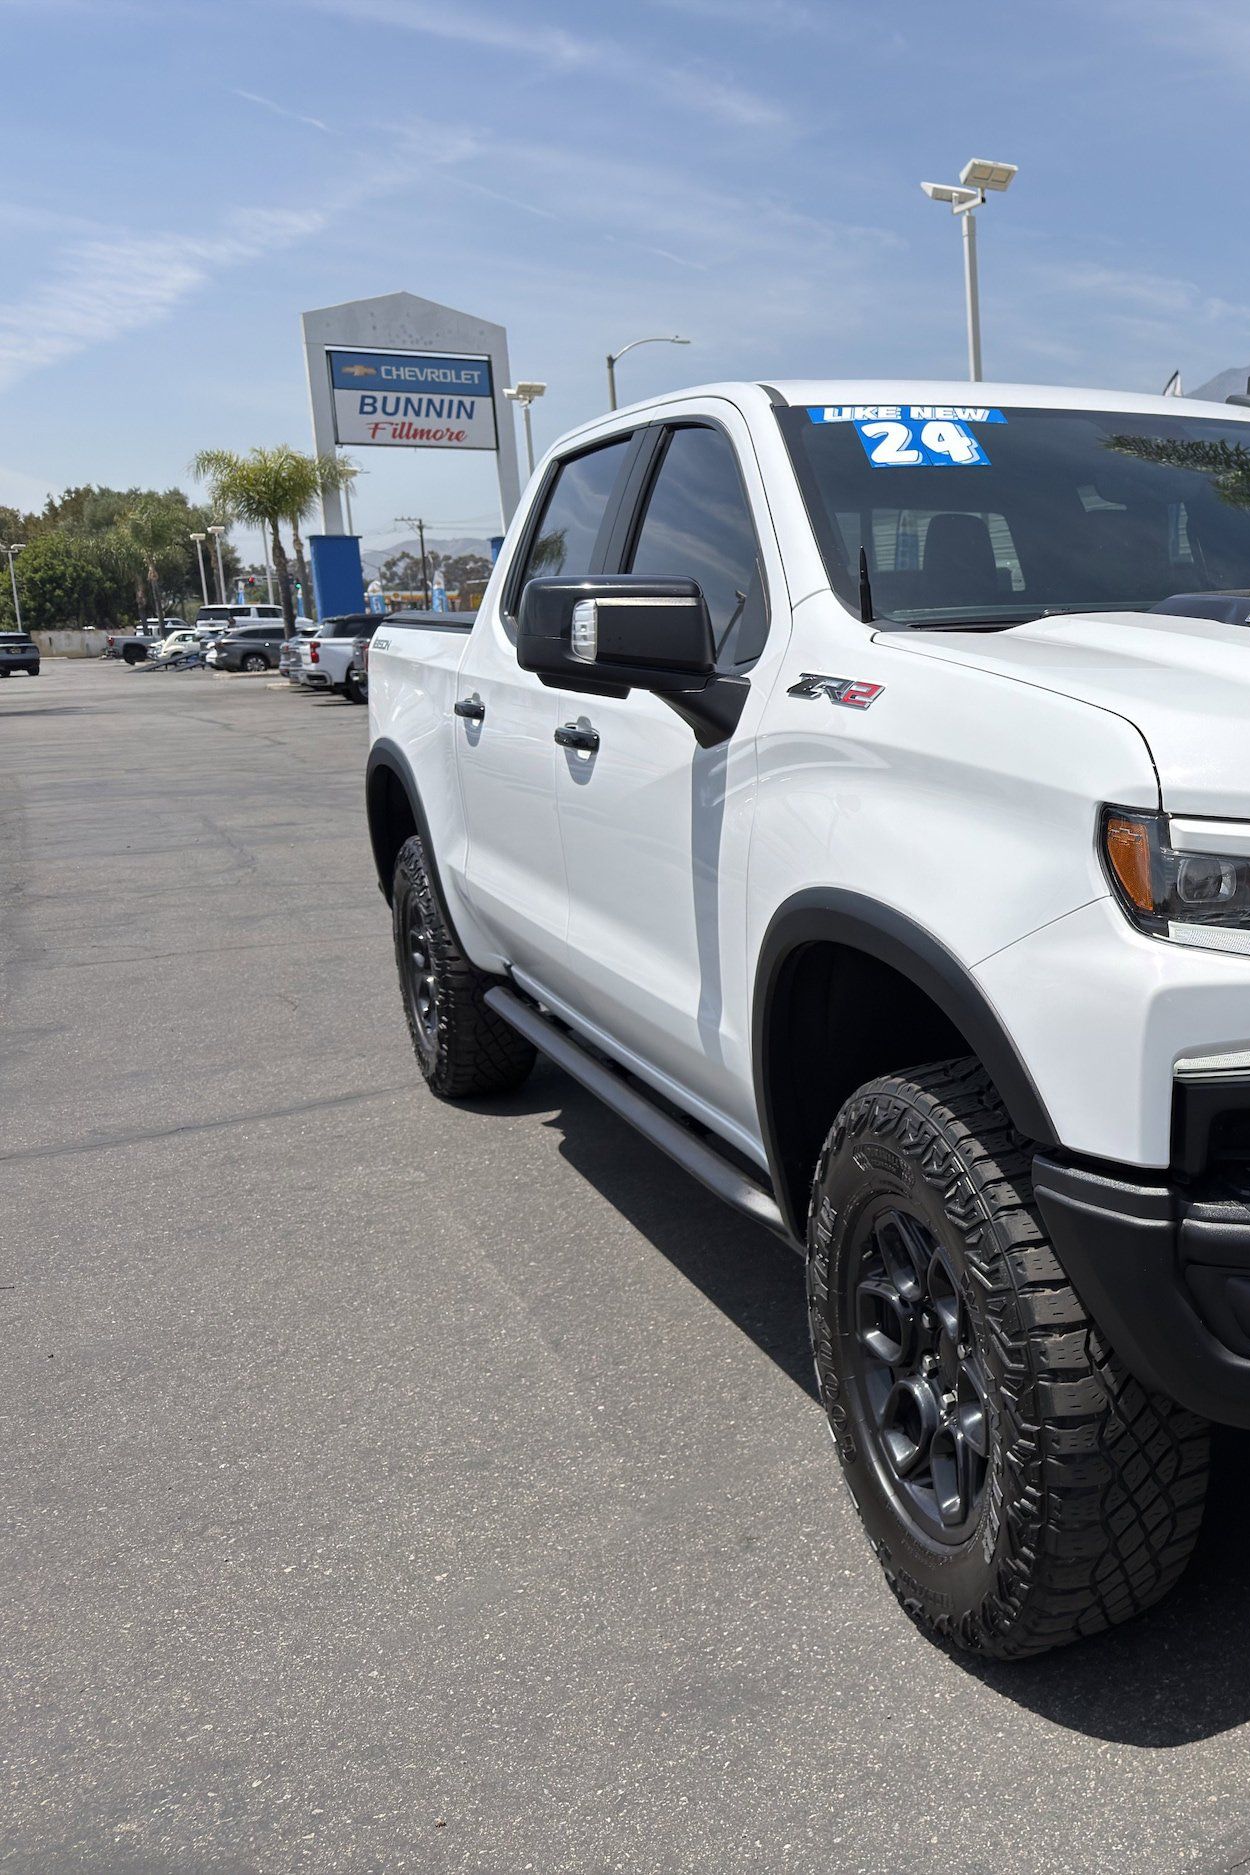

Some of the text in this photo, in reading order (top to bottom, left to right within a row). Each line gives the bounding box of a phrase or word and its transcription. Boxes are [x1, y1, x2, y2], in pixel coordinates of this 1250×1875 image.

[380, 365, 481, 384] CHEVROLET
[358, 394, 475, 420] BUNNIN
[823, 406, 990, 422] LIKE NEW
[366, 421, 467, 443] Fillmore
[861, 421, 981, 465] 24
[786, 672, 886, 711] ZR2
